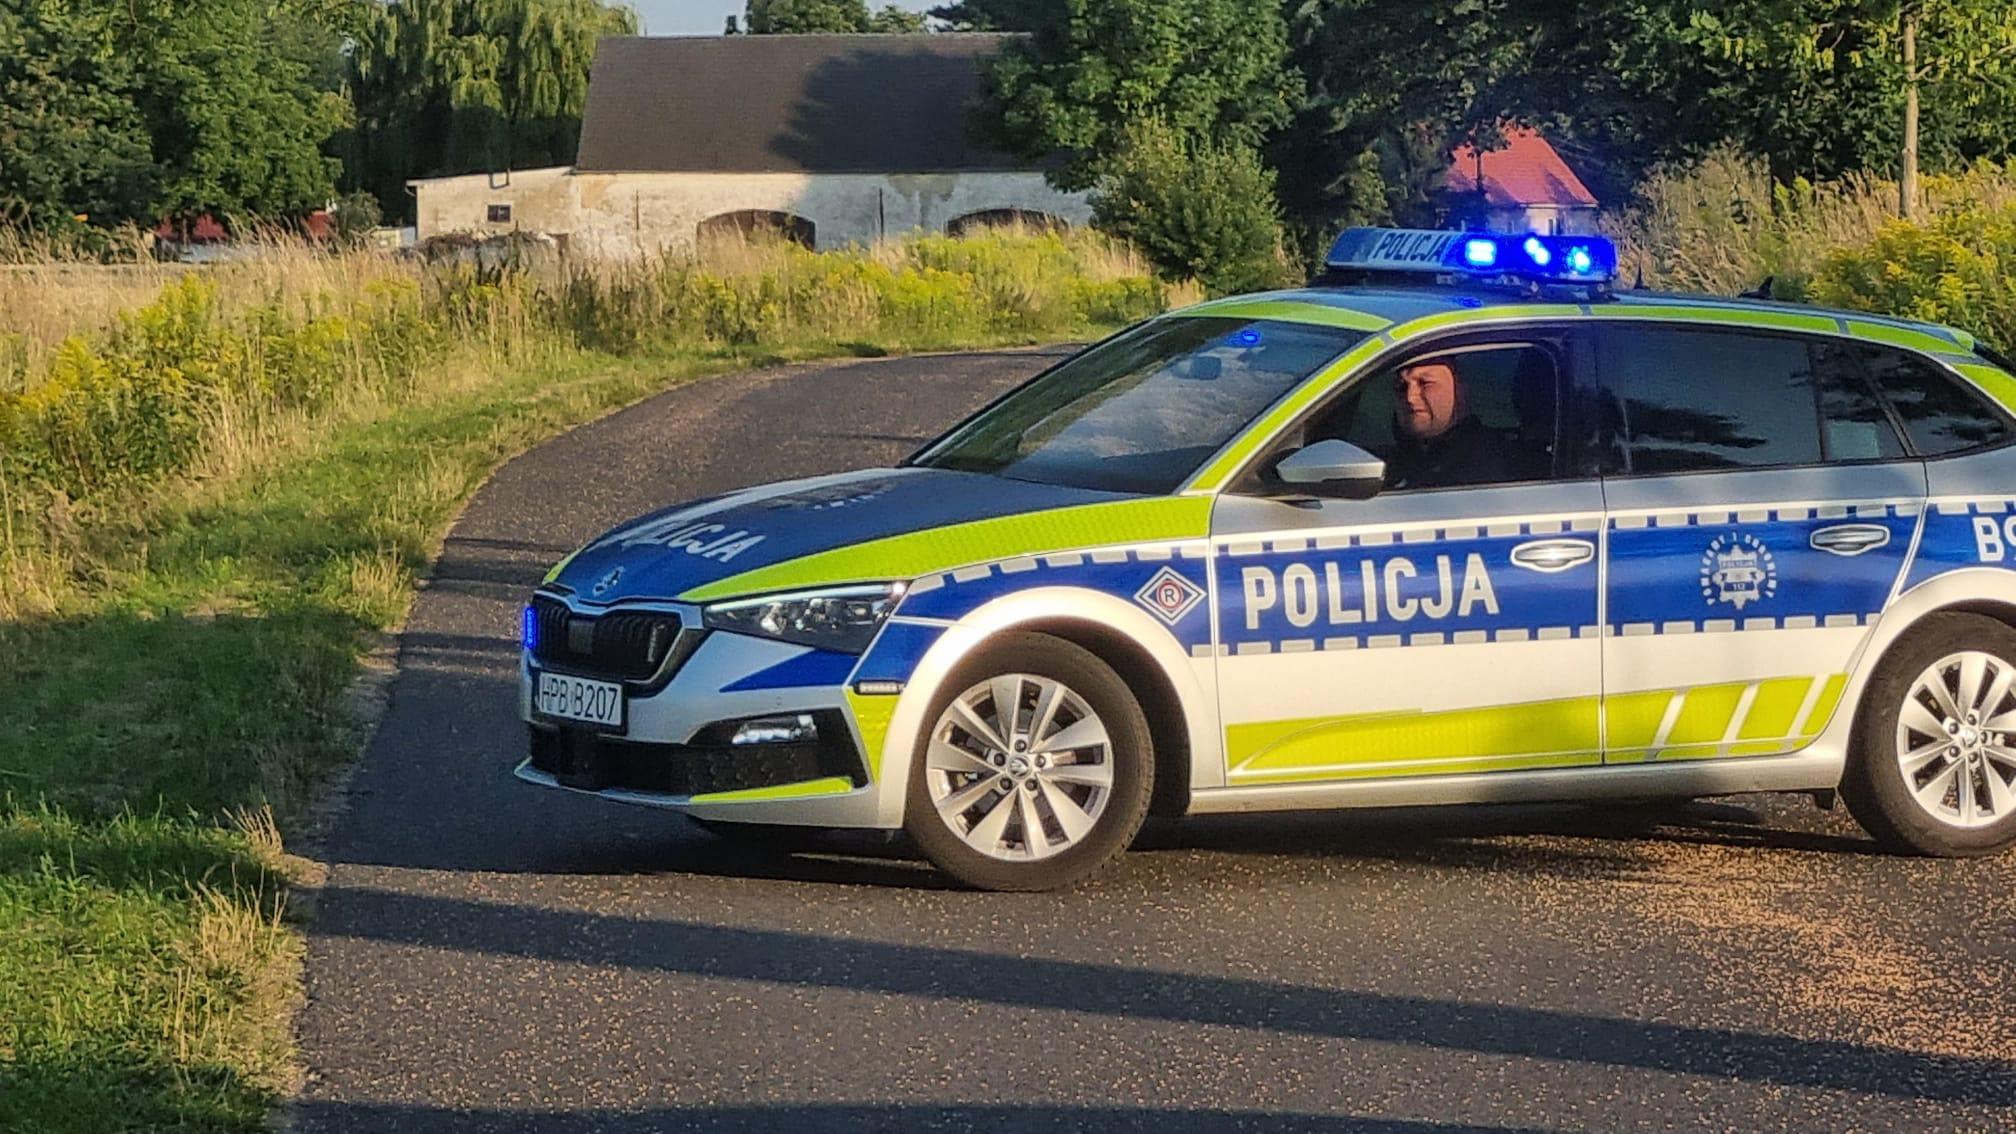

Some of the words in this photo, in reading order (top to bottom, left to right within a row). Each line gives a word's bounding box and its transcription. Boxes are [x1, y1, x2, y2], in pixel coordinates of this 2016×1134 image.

[1372, 232, 1451, 262] POLICJA
[1163, 588, 1177, 602] R
[1242, 552, 1501, 630] POLICJA
[541, 676, 569, 714] HPB
[574, 682, 618, 721] B207
